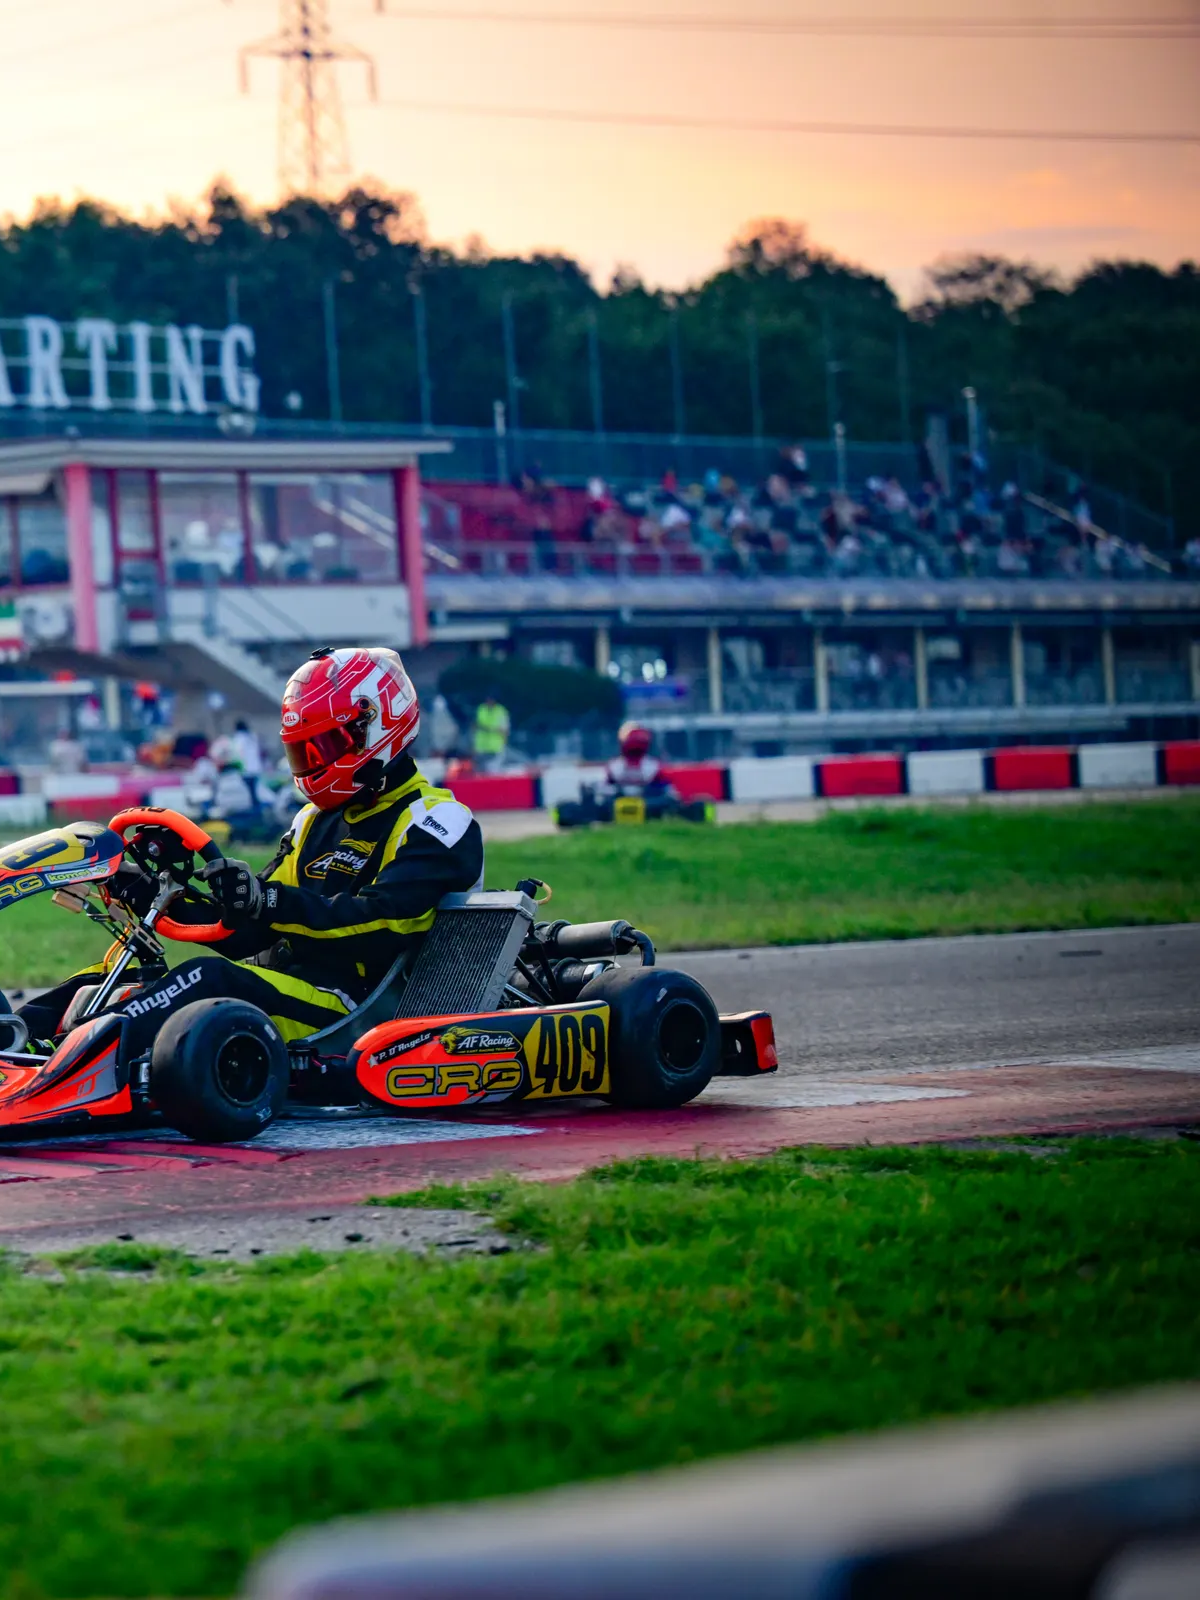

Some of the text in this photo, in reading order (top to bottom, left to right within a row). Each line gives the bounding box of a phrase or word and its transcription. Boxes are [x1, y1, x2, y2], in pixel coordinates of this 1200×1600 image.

[458, 1034, 515, 1049] AF Racing
[535, 1015, 605, 1093] 409
[387, 1060, 522, 1097] CRG
